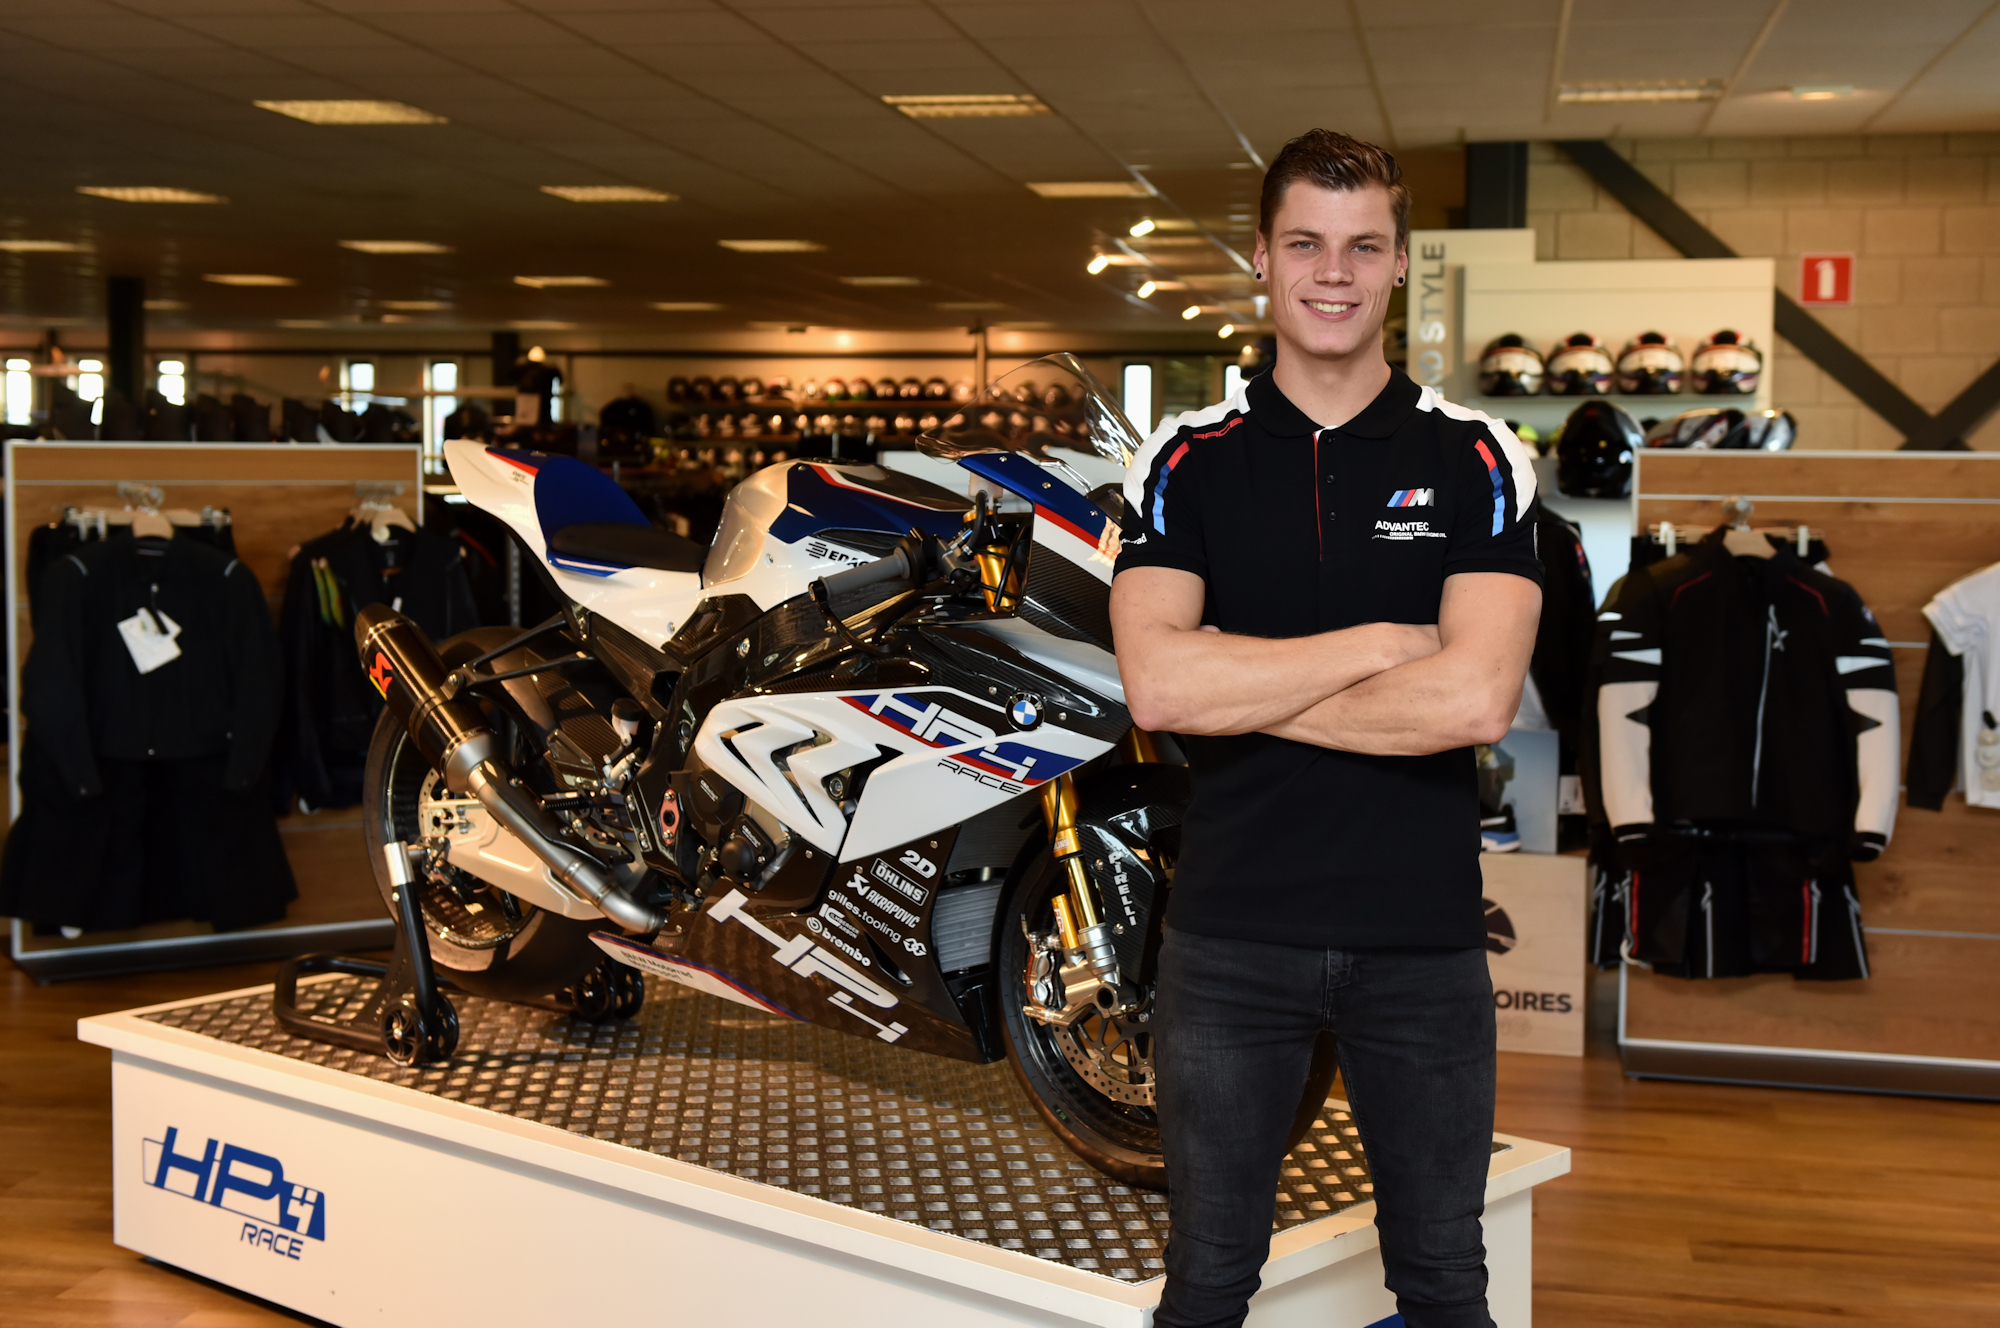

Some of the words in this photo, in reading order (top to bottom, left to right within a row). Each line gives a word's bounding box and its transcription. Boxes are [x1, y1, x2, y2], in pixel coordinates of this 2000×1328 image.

[1419, 242, 1446, 344] STYLE
[1374, 520, 1429, 532] ADVANTEC
[868, 692, 1038, 783] HP4
[937, 758, 1024, 795] RACE
[875, 862, 925, 902] ÖHLINS
[899, 849, 937, 879] 2D
[1108, 851, 1137, 926] PIRELLI
[827, 889, 902, 944] gilles.tooling
[821, 927, 871, 967] brembo
[1493, 990, 1573, 1013] OIRES
[150, 1126, 325, 1241] HP4
[240, 1222, 304, 1261] RACE
